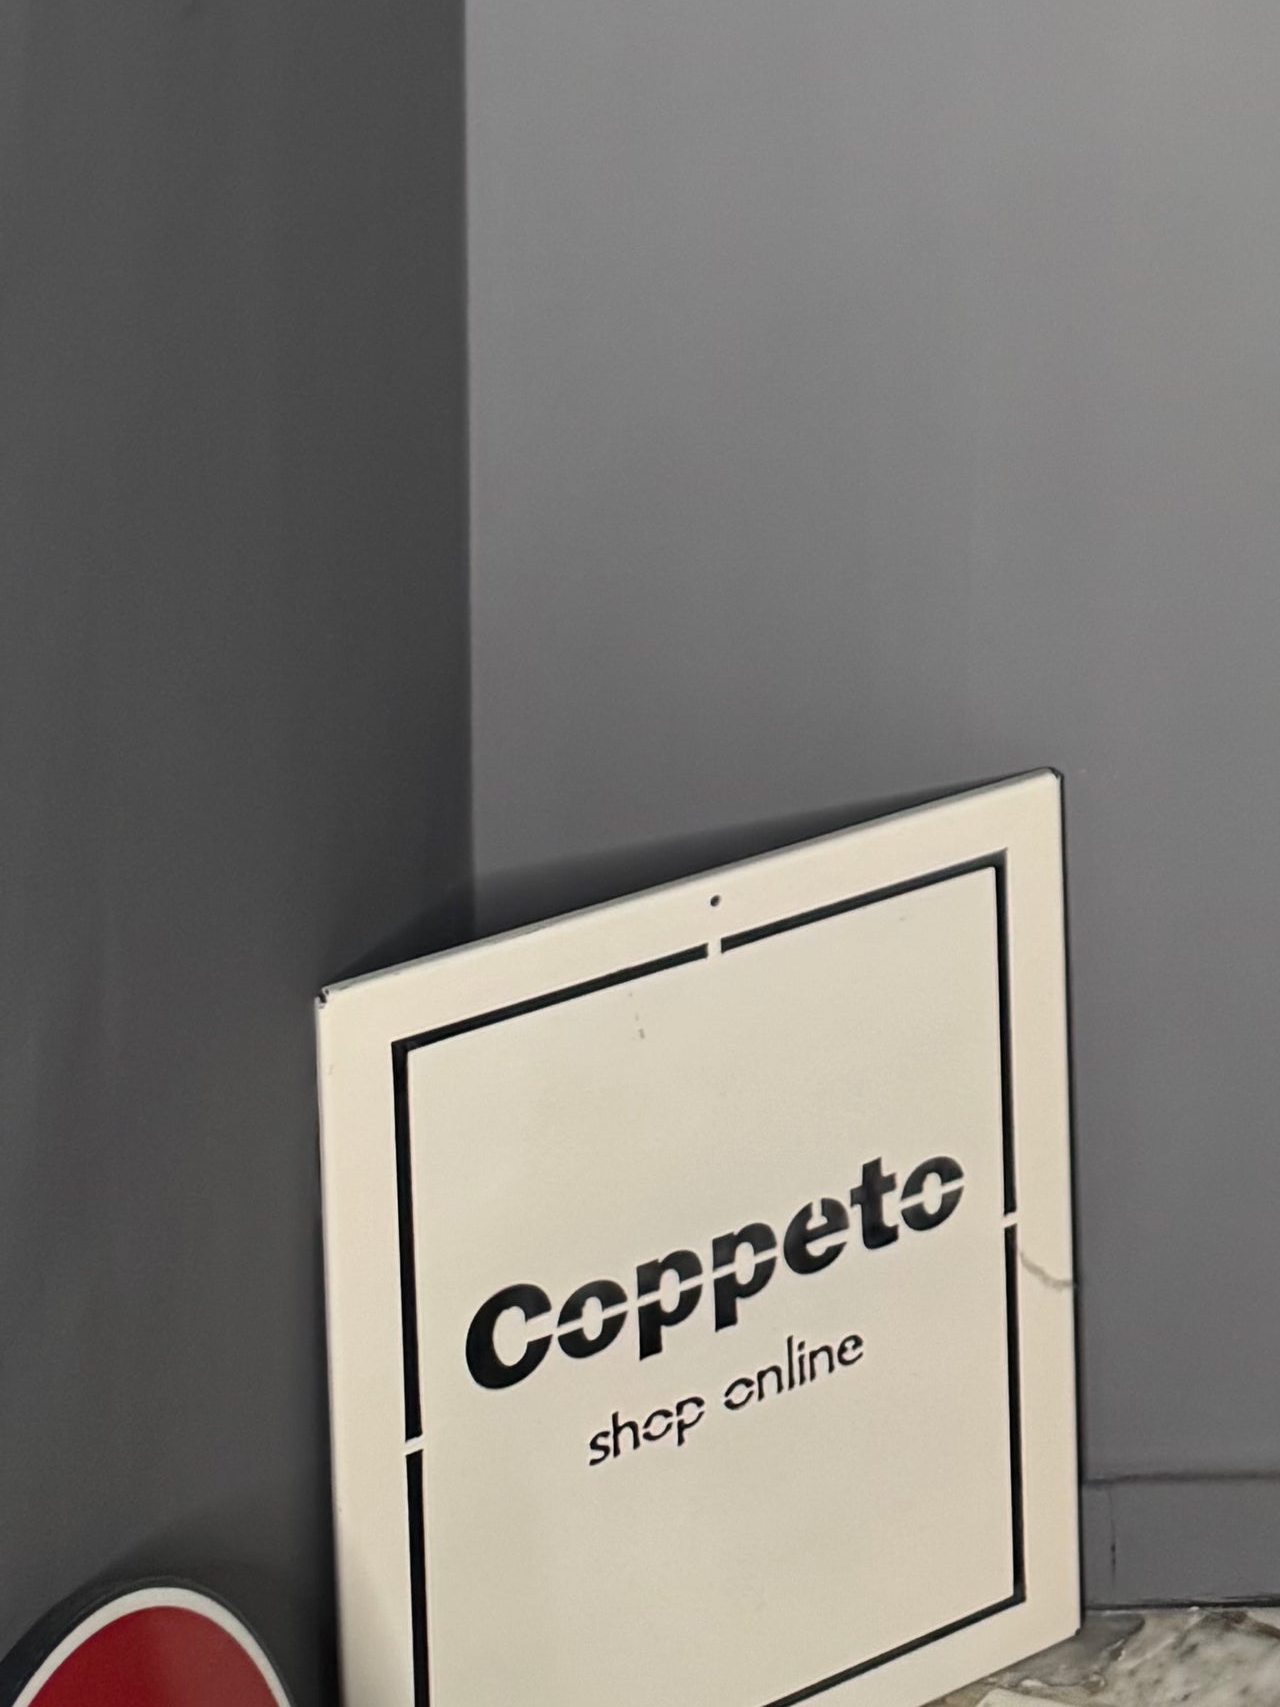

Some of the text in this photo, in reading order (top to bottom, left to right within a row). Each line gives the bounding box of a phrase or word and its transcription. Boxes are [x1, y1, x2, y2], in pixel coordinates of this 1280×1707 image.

[463, 1154, 965, 1391] Coppeto
[587, 1329, 866, 1467] shop online
